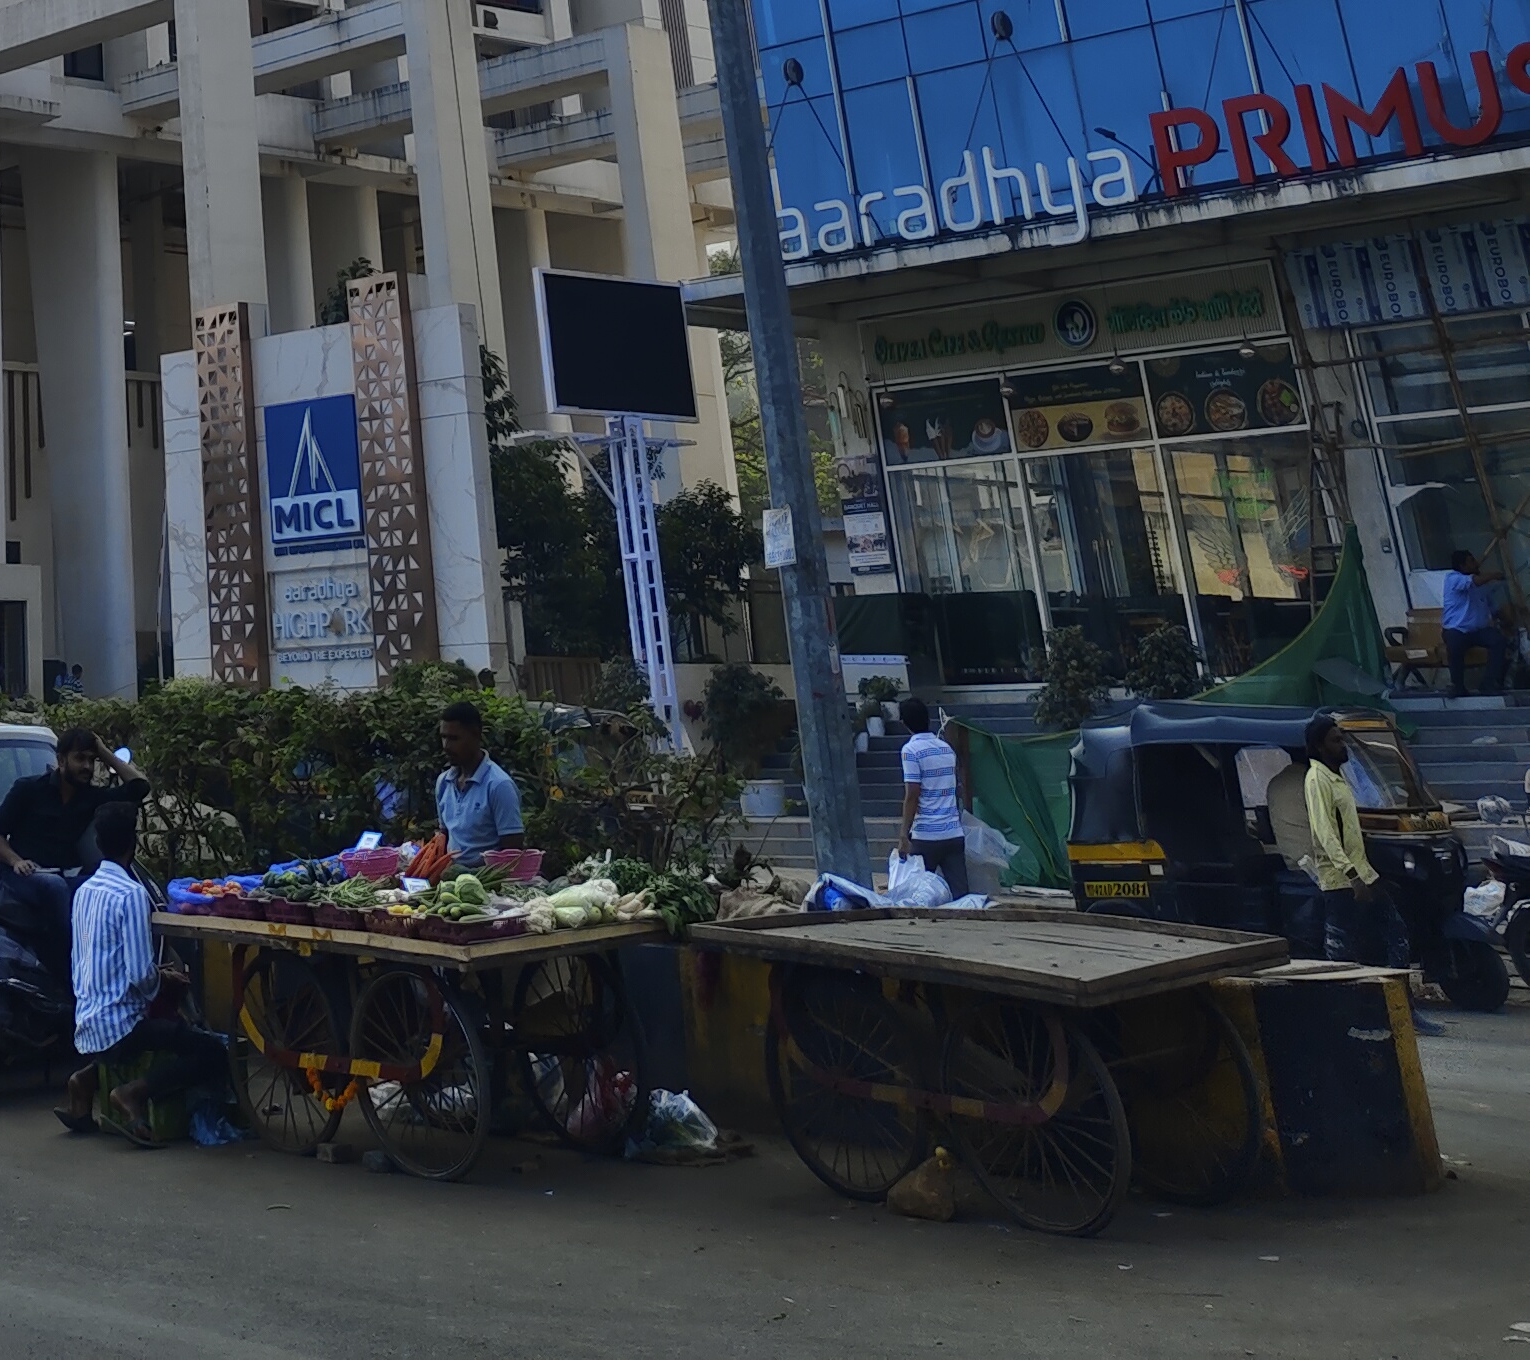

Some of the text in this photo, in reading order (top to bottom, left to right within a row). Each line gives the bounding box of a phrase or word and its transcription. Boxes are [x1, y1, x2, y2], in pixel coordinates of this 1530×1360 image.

[777, 144, 1140, 262] aaradhya
[274, 498, 355, 534] MICL
[285, 577, 359, 606] aaradhya
[328, 647, 373, 660] EXPECTED
